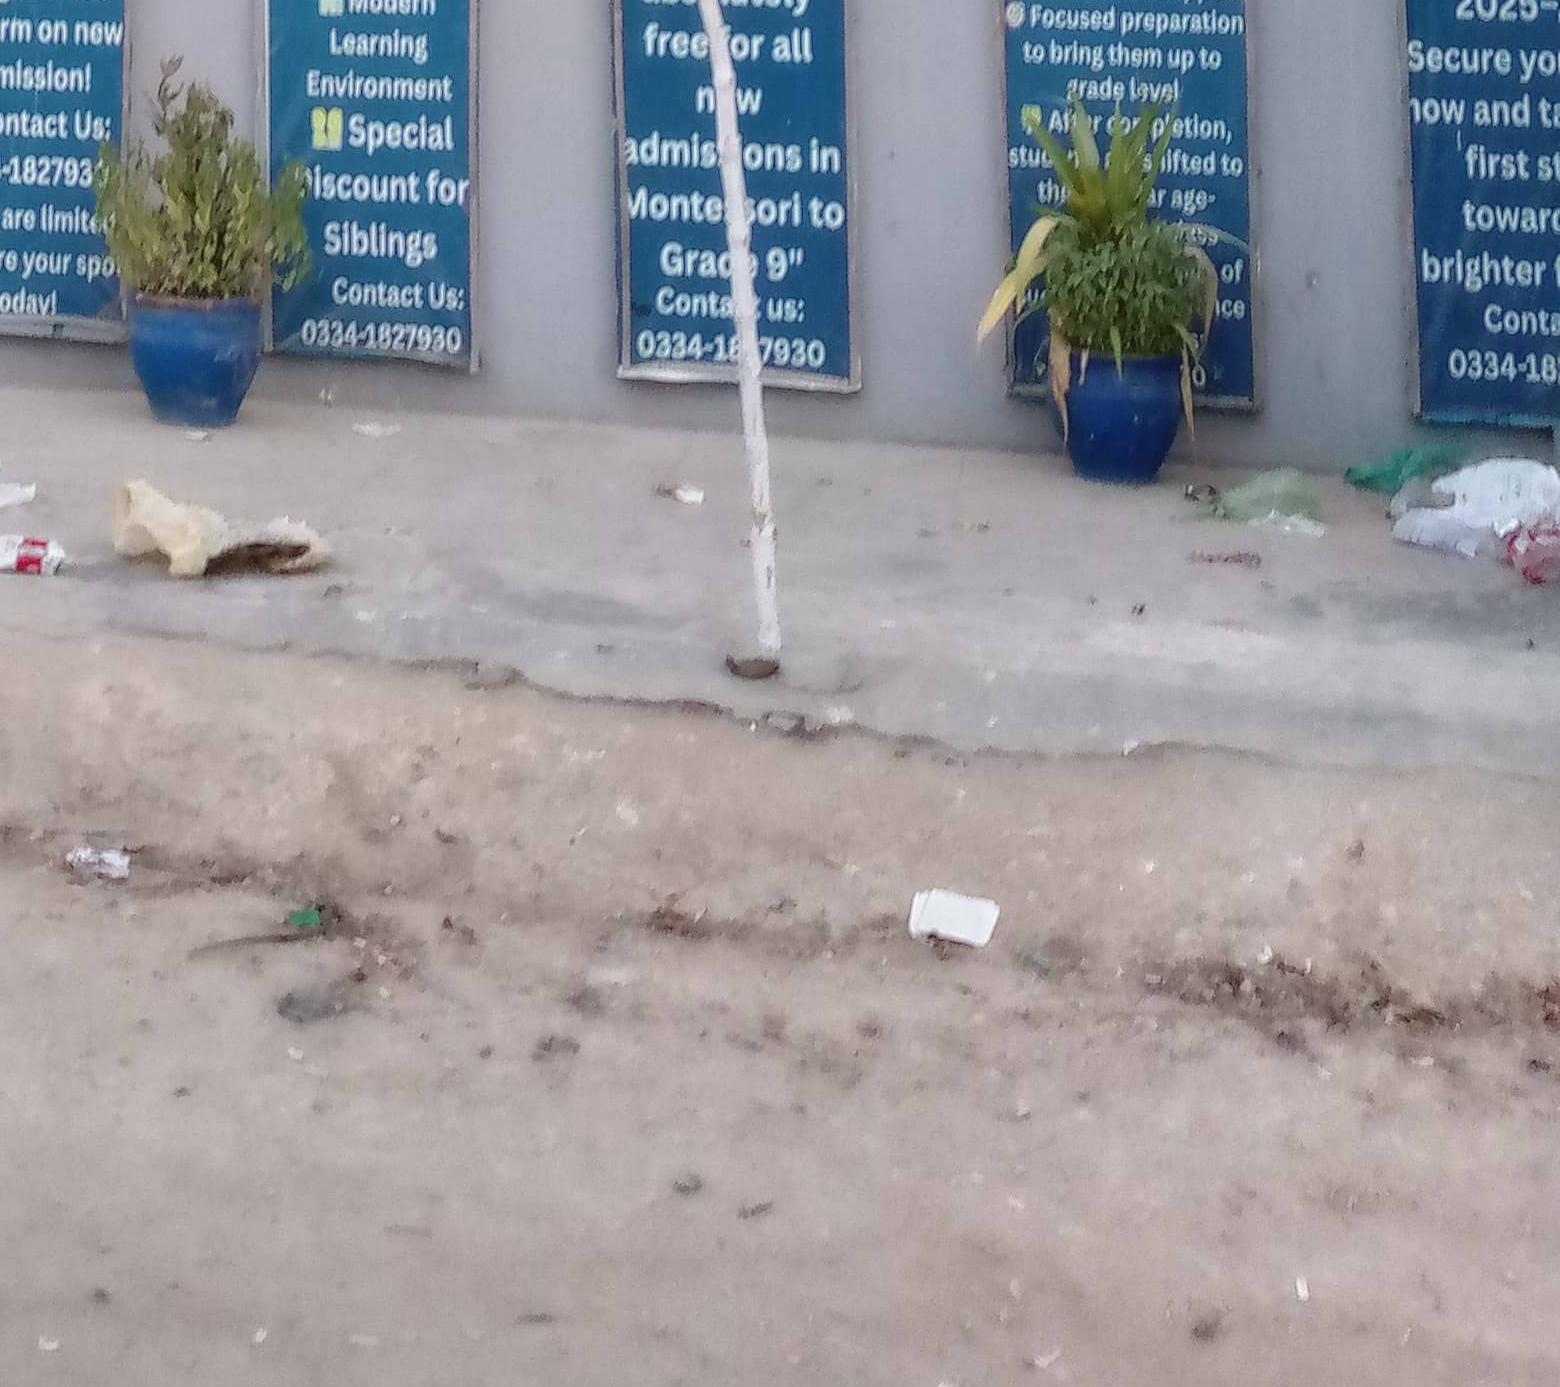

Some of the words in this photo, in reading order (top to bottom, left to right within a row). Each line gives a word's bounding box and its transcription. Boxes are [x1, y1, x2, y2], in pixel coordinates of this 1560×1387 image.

[38, 17, 68, 45] on
[74, 21, 124, 47] new
[1030, 2, 1116, 32] Focused
[1119, 5, 1245, 39] preparation
[329, 29, 429, 65] Learning
[642, 21, 711, 60] free
[771, 25, 814, 64] all
[1022, 40, 1045, 64] to
[1049, 38, 1104, 73] bring
[1108, 41, 1170, 70] them
[1168, 45, 1195, 76] up
[1199, 44, 1222, 70] to
[1407, 38, 1513, 75] Secure
[306, 69, 453, 103] Environment
[696, 87, 762, 116] nw
[1066, 76, 1125, 104] grade
[73, 110, 112, 141] Us:
[1472, 93, 1531, 128] and
[347, 113, 454, 156] Special
[809, 136, 841, 176] in
[1221, 151, 1244, 177] to
[1464, 144, 1530, 181] first
[425, 168, 470, 207] for
[2, 206, 37, 230] are
[808, 197, 846, 232] to
[323, 221, 438, 267] Siblings
[22, 249, 72, 279] your
[1221, 258, 1244, 285] of
[1421, 247, 1547, 293] brighter
[332, 276, 424, 309] Contact
[655, 284, 761, 318] Contat
[300, 318, 462, 354] 0334-1827930
